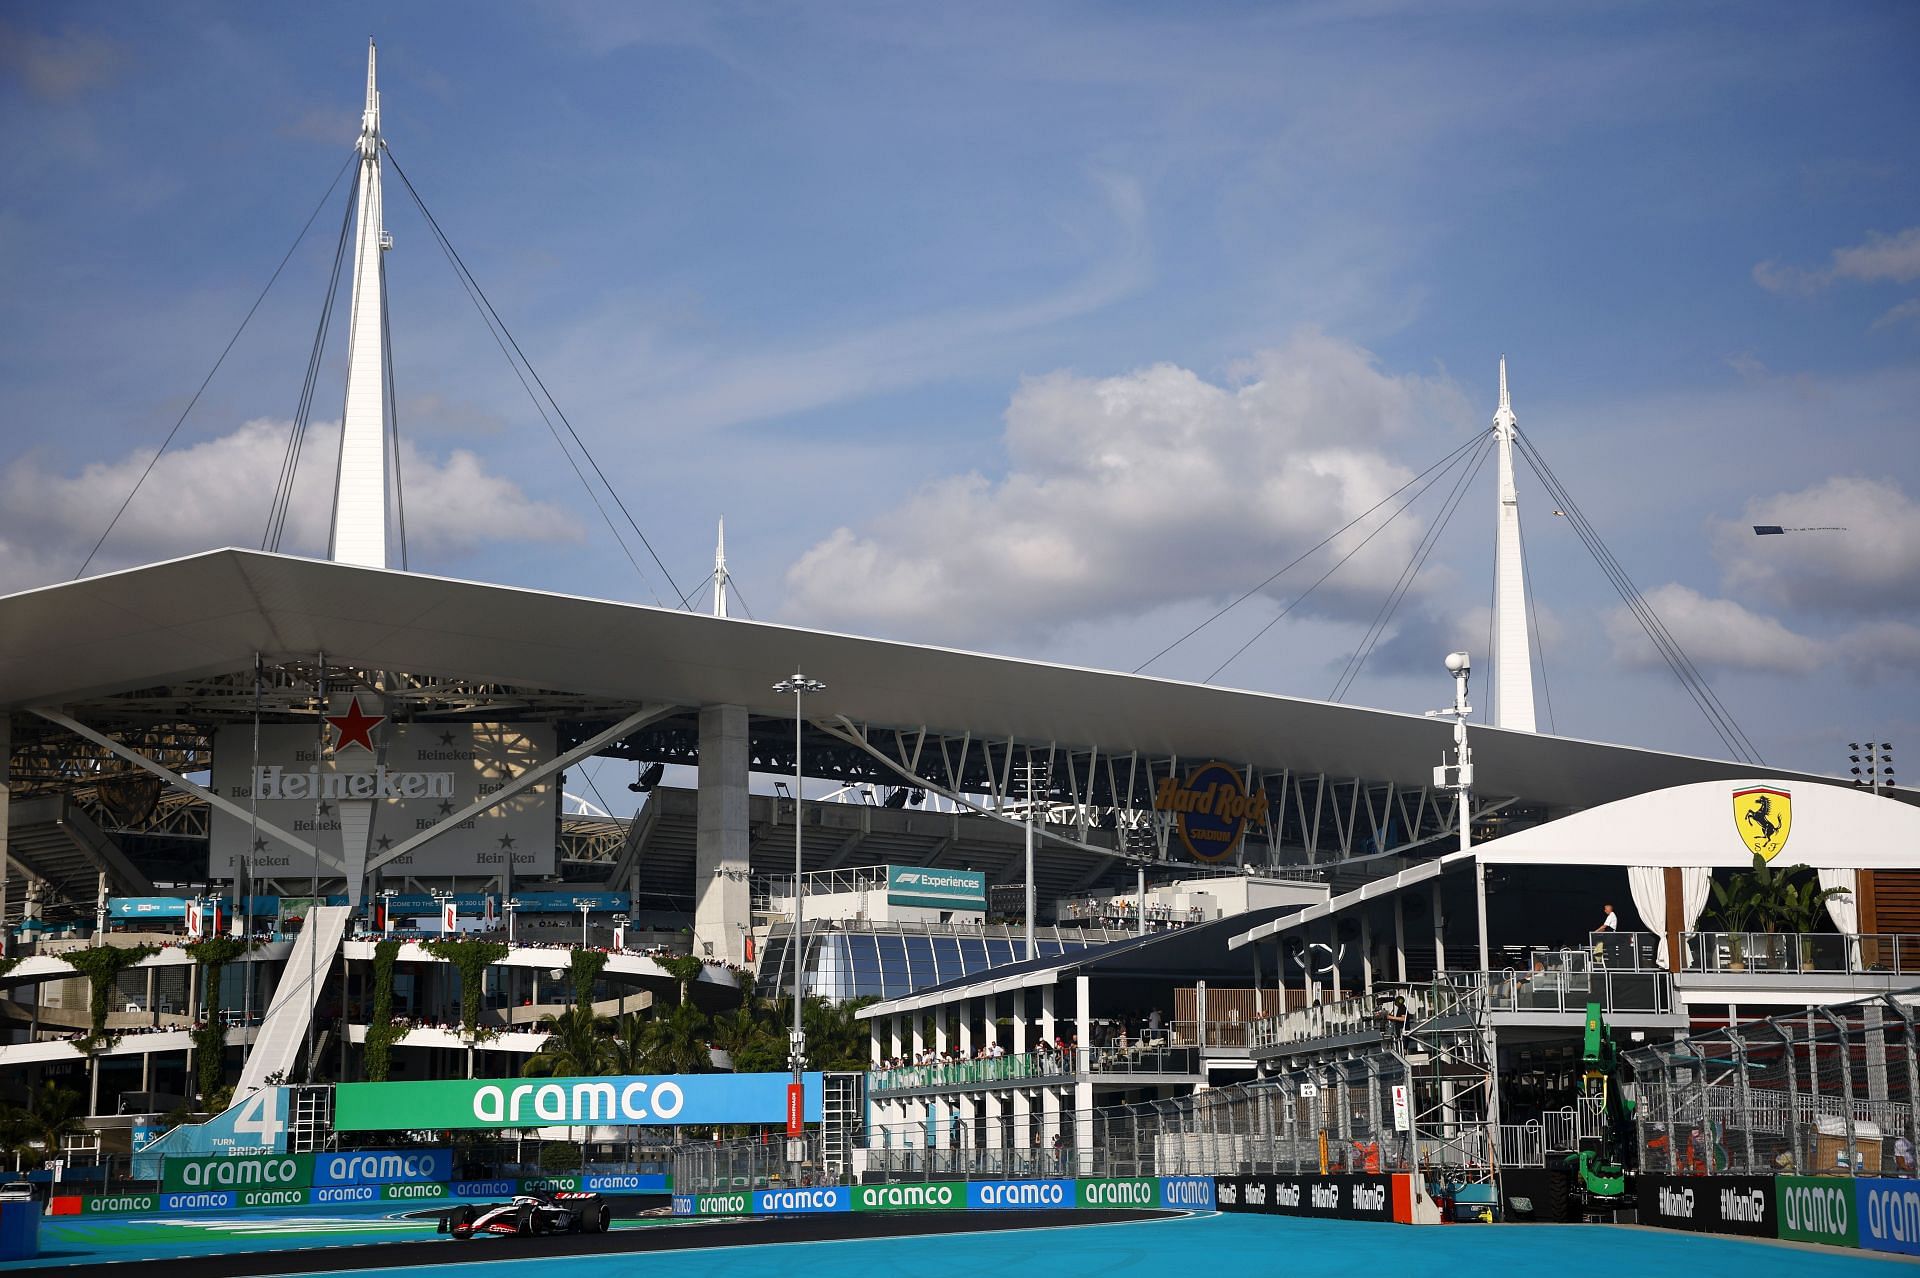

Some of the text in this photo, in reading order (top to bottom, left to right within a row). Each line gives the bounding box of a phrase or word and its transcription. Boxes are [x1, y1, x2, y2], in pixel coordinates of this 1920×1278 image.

[418, 750, 475, 761] Heineken
[252, 765, 454, 800] Heineken
[1155, 777, 1269, 825] Hard Rock
[1190, 829, 1231, 841] STADIUM
[921, 875, 980, 889] Experiences
[473, 1081, 684, 1122] aramco
[234, 1085, 284, 1145] 4
[212, 1138, 236, 1146] TURN
[228, 1146, 275, 1156] BRIDGE
[183, 1159, 297, 1186] aramco
[329, 1155, 435, 1180] aramco
[389, 1184, 442, 1198] aramco
[457, 1183, 509, 1195] aramco
[589, 1177, 639, 1189] aramco
[1086, 1182, 1151, 1204] aramco
[1167, 1181, 1209, 1205] aramco
[91, 1197, 151, 1211] aramco
[169, 1194, 228, 1208] aramco
[245, 1190, 301, 1205] aramco
[318, 1187, 372, 1201] aramco
[763, 1190, 837, 1210] aramco
[863, 1186, 953, 1206] aramco
[980, 1184, 1063, 1204] aramco
[1352, 1182, 1385, 1211] #MiamiGP
[1659, 1185, 1694, 1218] #MiamiGP
[700, 1196, 744, 1213] aramco
[1720, 1187, 1764, 1223] #MiamiGP
[1785, 1186, 1847, 1236] aramco
